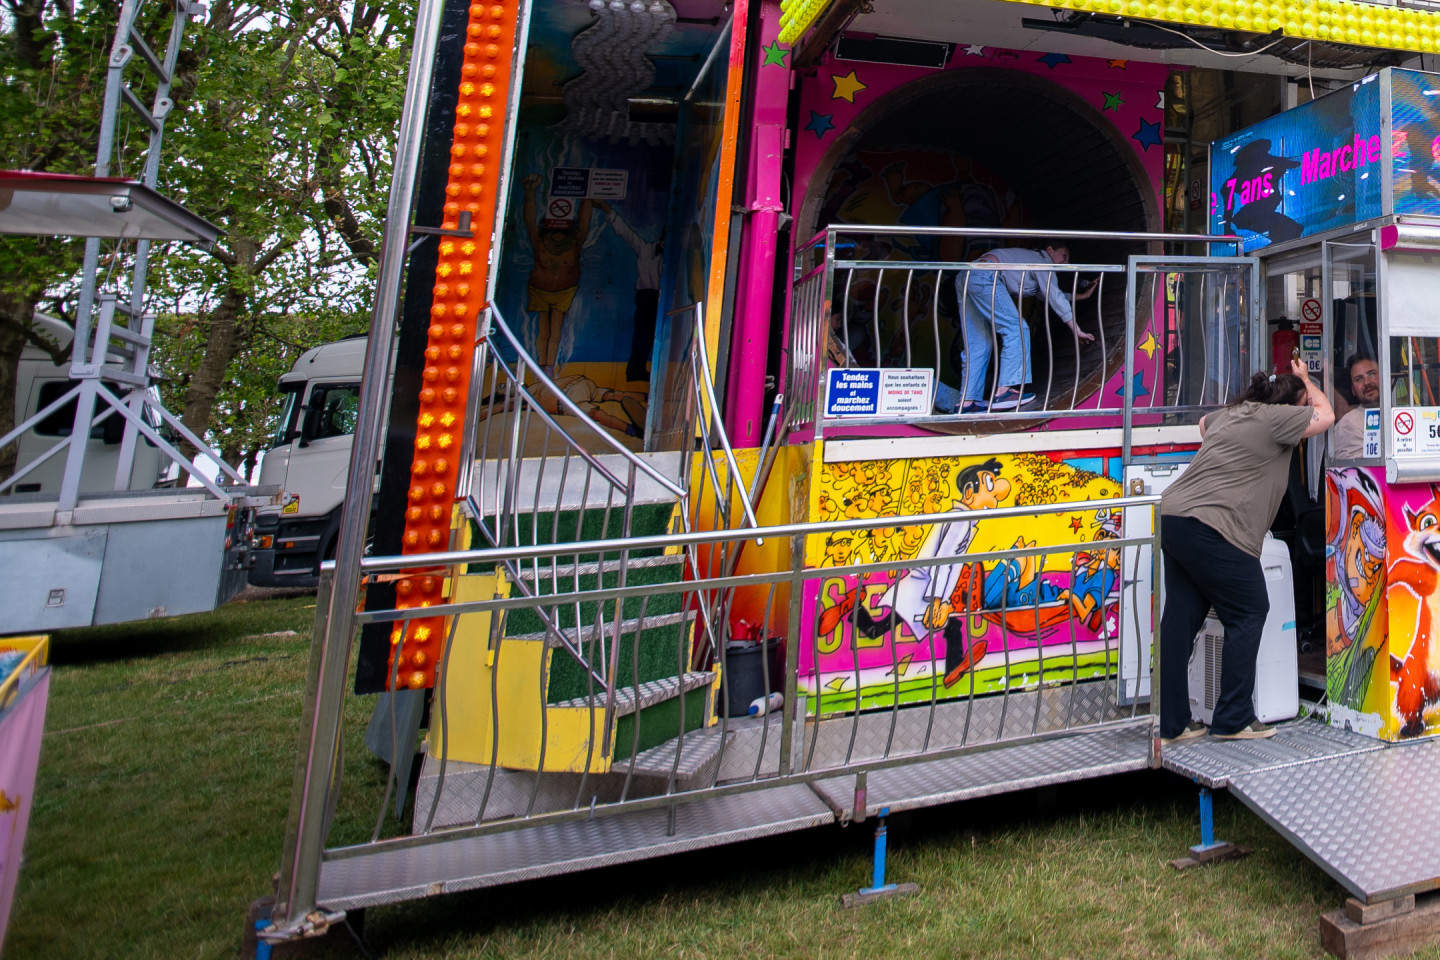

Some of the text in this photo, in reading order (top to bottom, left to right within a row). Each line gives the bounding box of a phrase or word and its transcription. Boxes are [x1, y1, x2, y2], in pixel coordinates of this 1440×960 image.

[1226, 178, 1237, 210] 7
[1240, 172, 1273, 205] ans
[1304, 338, 1320, 348] CB
[842, 373, 869, 381] Tendez
[836, 381, 873, 389] les mains
[837, 396, 870, 404] marchez
[831, 404, 874, 412] doucement
[1367, 414, 1379, 427] CB
[1366, 442, 1379, 456] 10€
